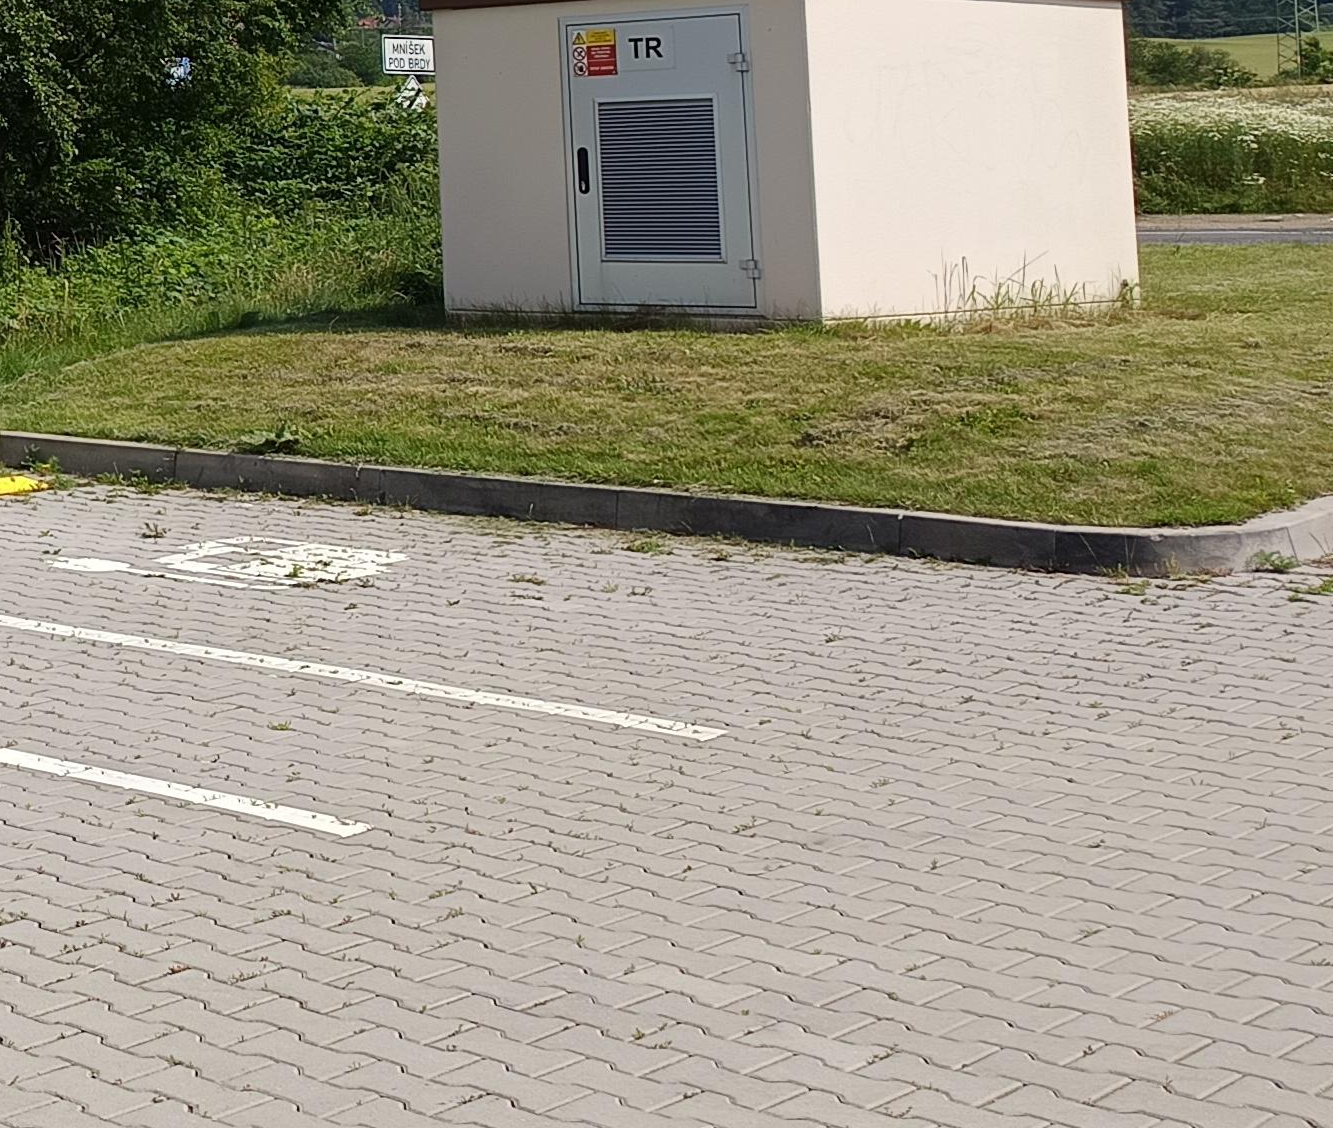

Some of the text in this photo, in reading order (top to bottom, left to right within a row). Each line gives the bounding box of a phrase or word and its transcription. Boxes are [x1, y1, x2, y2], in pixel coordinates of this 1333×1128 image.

[393, 41, 426, 55] MNÍŠEK
[628, 37, 663, 59] TR
[389, 57, 430, 70] POD BRDY
